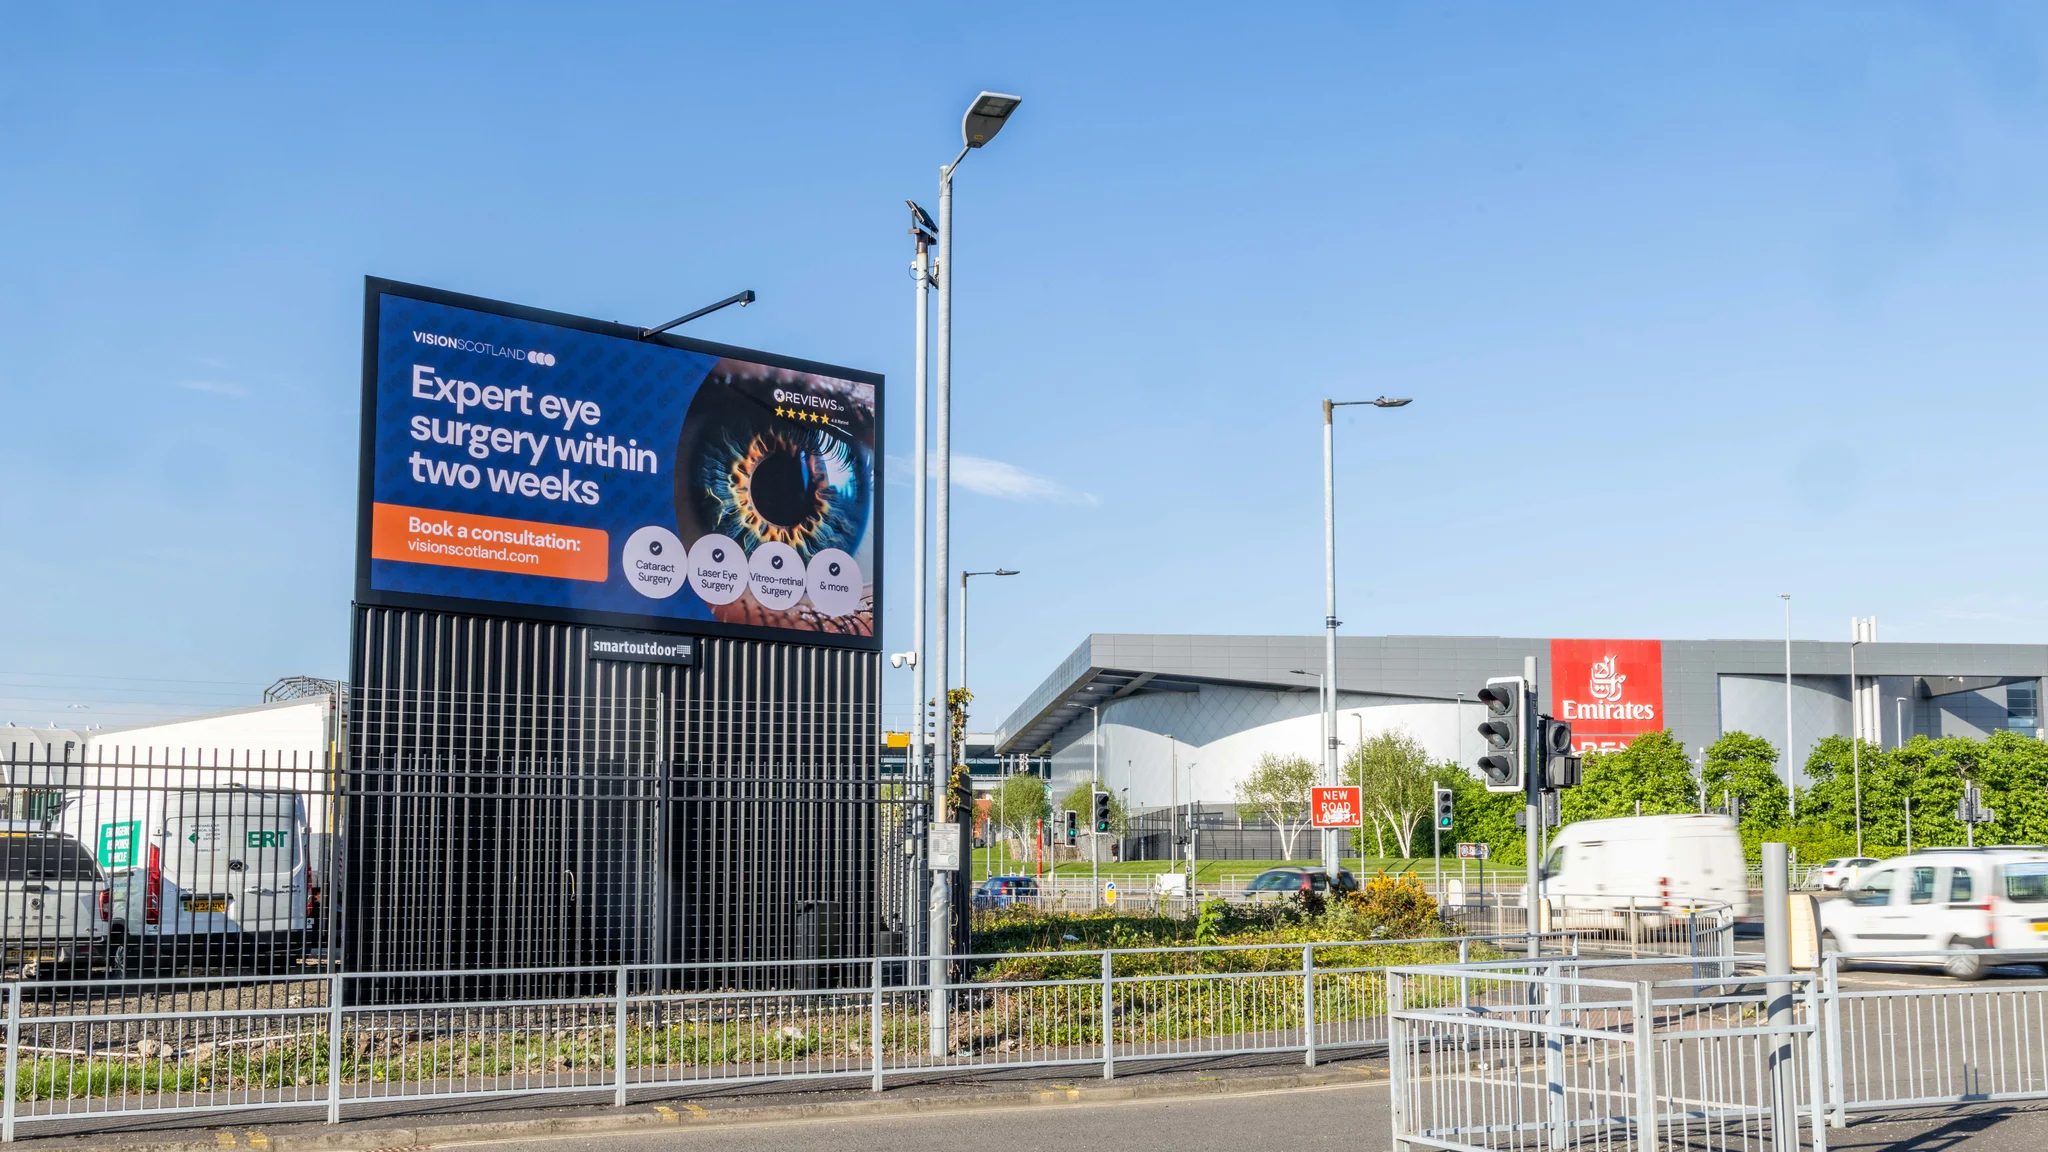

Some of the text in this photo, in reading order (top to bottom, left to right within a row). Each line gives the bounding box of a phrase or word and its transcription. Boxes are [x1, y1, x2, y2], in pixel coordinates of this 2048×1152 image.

[413, 331, 526, 361] VISIONSCOTLAND
[412, 364, 601, 431] Expert eye
[410, 415, 657, 474] surgery within
[409, 451, 600, 505] two weeks
[408, 516, 581, 552] Book a consultation:
[408, 540, 539, 565] visionscotland.com
[635, 559, 675, 573] Cataract
[697, 567, 738, 581] Laser Eye
[638, 571, 673, 586] Surgery
[701, 580, 735, 593] Surgery
[750, 572, 804, 587] Vitreo-retinal
[761, 585, 793, 599] Surgery
[820, 581, 849, 593] & more
[593, 640, 677, 657] smartoutdoor
[1562, 699, 1655, 720] Emirates
[1323, 790, 1348, 800] NEW
[1321, 802, 1351, 812] ROAD
[247, 831, 288, 848] ERT
